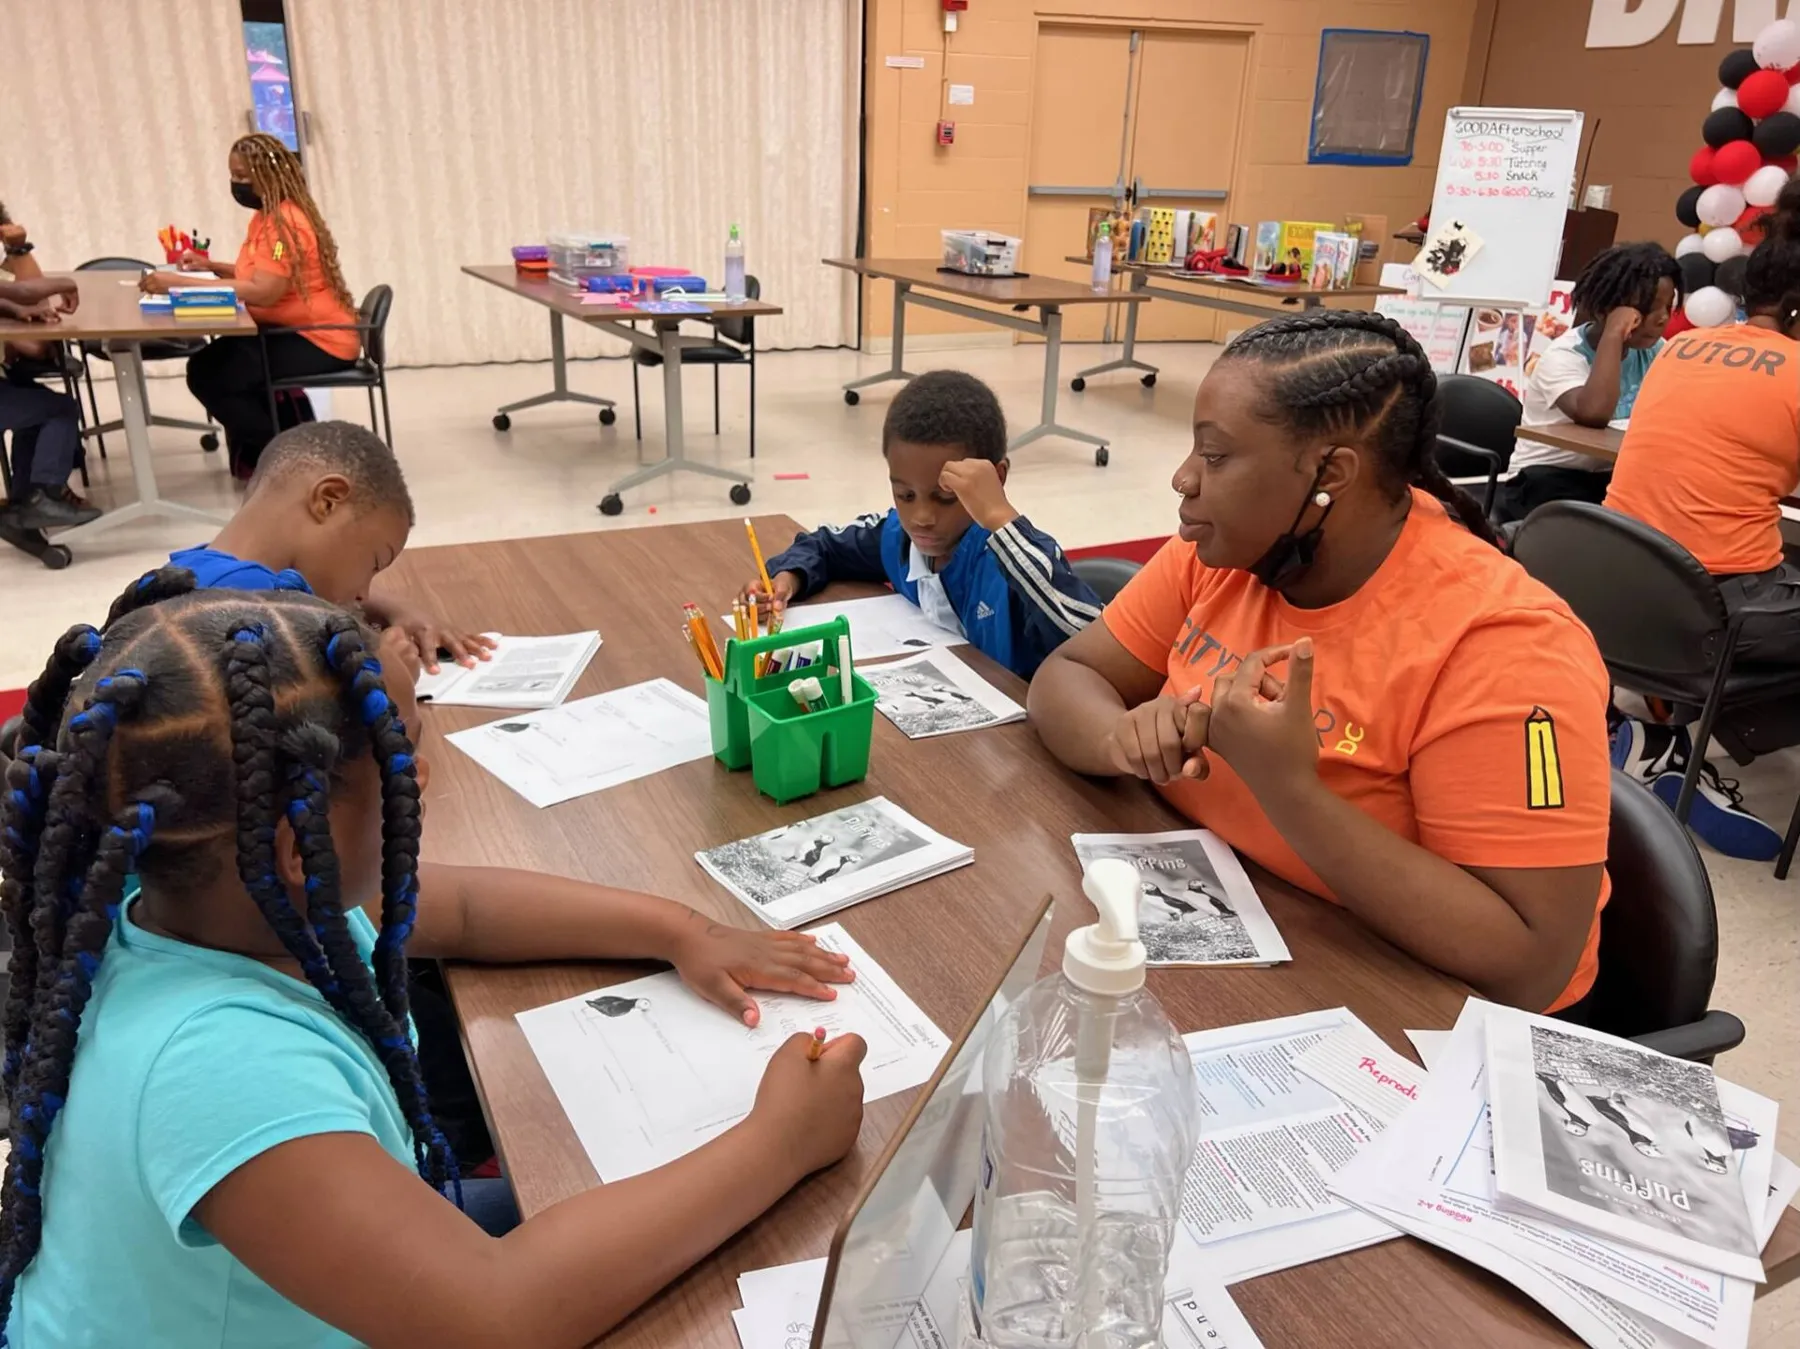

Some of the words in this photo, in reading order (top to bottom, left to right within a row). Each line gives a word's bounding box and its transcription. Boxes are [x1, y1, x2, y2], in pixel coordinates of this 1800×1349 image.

[1511, 142, 1547, 155] Supper
[1506, 170, 1538, 181] Snack
[1662, 337, 1786, 376] TUTOR
[1335, 722, 1364, 756] DC
[1579, 1159, 1690, 1212] Puffins
[1417, 1199, 1434, 1209] A-Z
[1436, 1205, 1472, 1223] Reading
